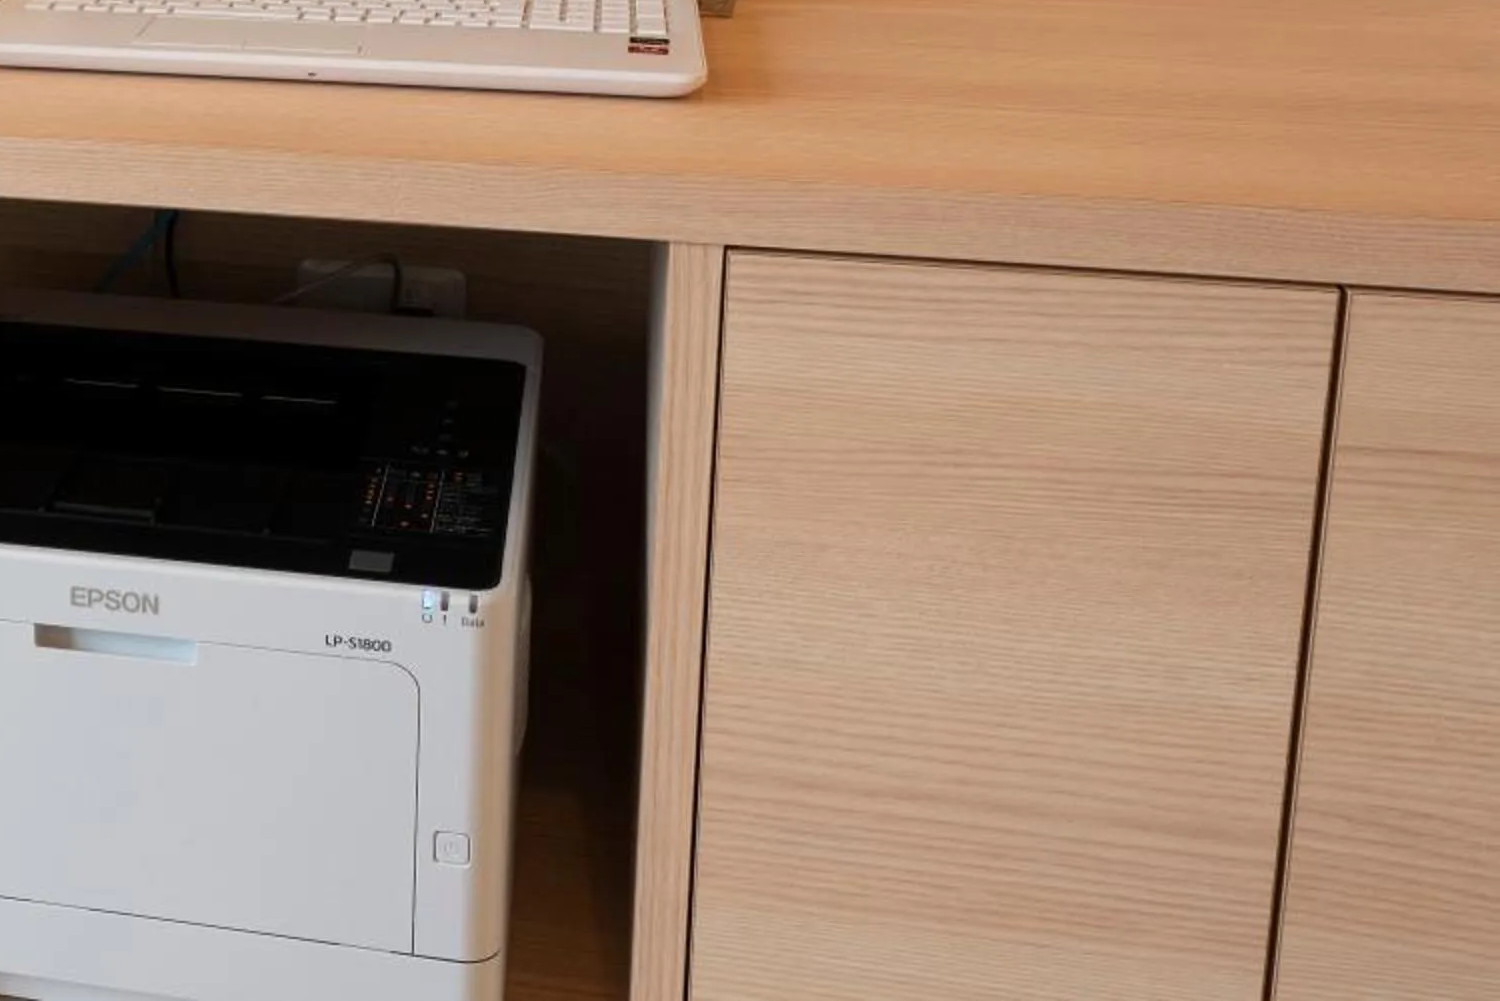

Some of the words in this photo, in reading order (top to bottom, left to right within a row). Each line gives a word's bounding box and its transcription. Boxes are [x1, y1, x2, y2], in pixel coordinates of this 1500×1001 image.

[69, 585, 161, 616] EPSON
[461, 616, 485, 628] Data
[324, 633, 393, 654] LP-S1800
